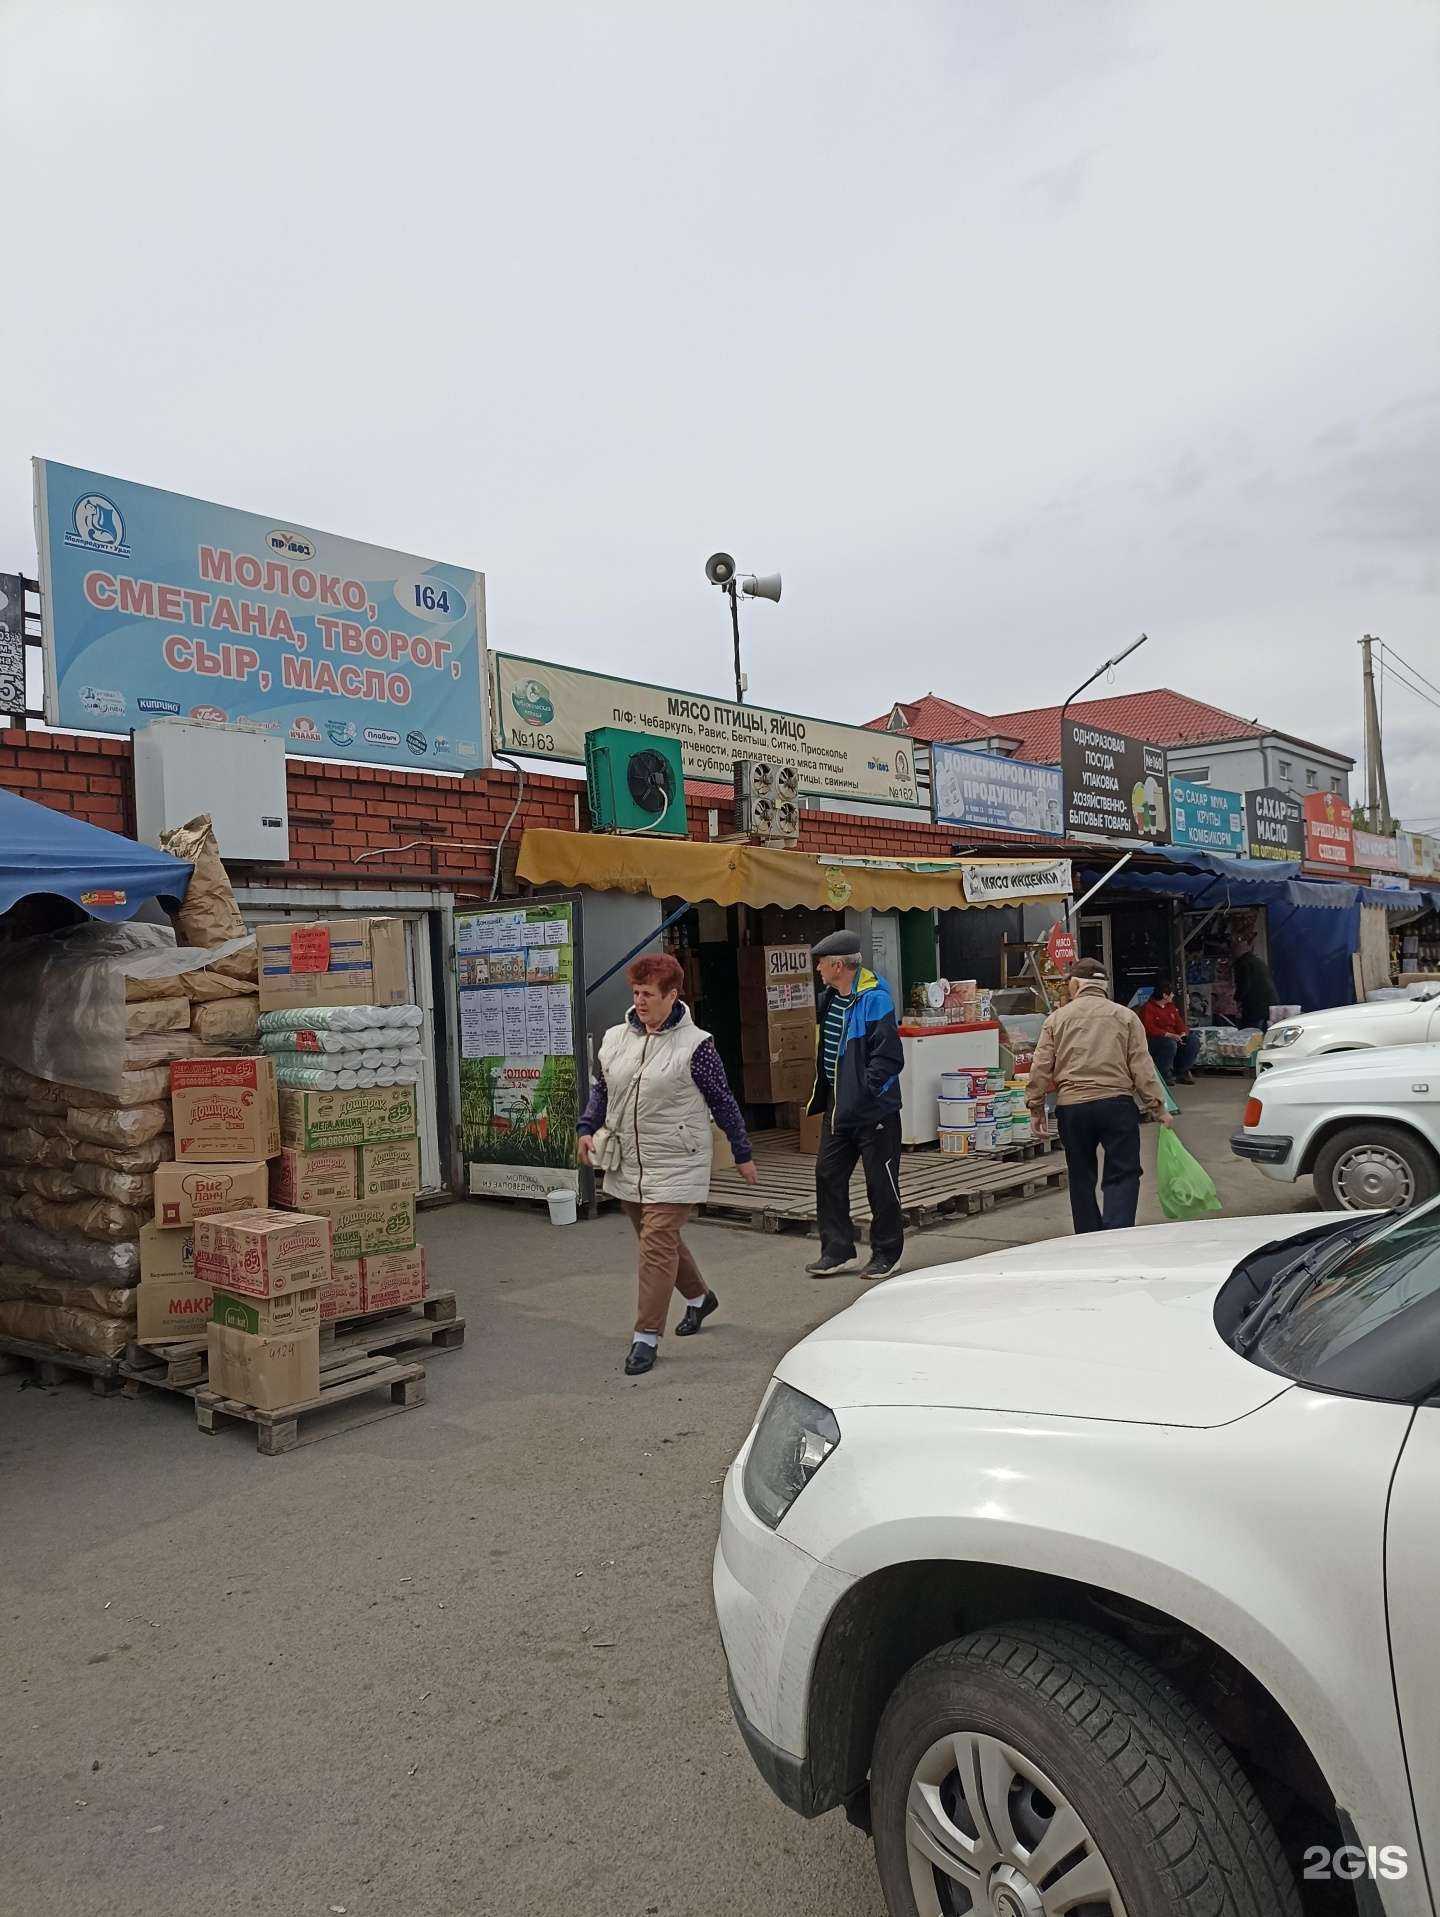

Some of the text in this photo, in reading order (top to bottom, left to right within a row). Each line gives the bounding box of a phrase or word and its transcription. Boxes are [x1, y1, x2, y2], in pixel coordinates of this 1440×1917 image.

[199, 546, 377, 620] МОЛОКО,
[414, 584, 450, 613] 164
[85, 571, 460, 678] СМЕТАНА, ТВОРОГ,
[164, 635, 411, 704] СЫР, МАСЛО
[667, 697, 806, 741] МЯСО ПТИЦЫ, ЯЙЦО
[511, 728, 555, 752] №163
[612, 708, 848, 760] П/Ф: Чебаркуль, Равис, Бектыш, Ситно, Приосколье
[1073, 727, 1125, 754] ОДНОРАЗОВАЯ
[731, 748, 784, 764] деликатесы
[786, 757, 796, 767] из
[797, 759, 817, 770] мяса
[818, 762, 844, 774] птицы
[1085, 750, 1115, 771] ПОСУДА
[824, 777, 859, 789] свинины
[1082, 771, 1119, 791] УПАКОВКА
[888, 785, 913, 801] №162
[1072, 791, 1128, 813] ХОЗЯЙСТВЕННО-
[1185, 790, 1208, 806] САХАР
[1196, 809, 1221, 827] КРУПЫ
[1255, 795, 1286, 820] САХАР
[1069, 809, 1132, 832] БЫТОВЫЕ ТОВАРЫ
[1256, 820, 1288, 844] МАСЛО
[1188, 827, 1232, 846] КОМБИКОРМ
[981, 875, 1009, 890] МЯСО
[190, 1103, 243, 1126] Доширак
[339, 1098, 387, 1119] Доширак
